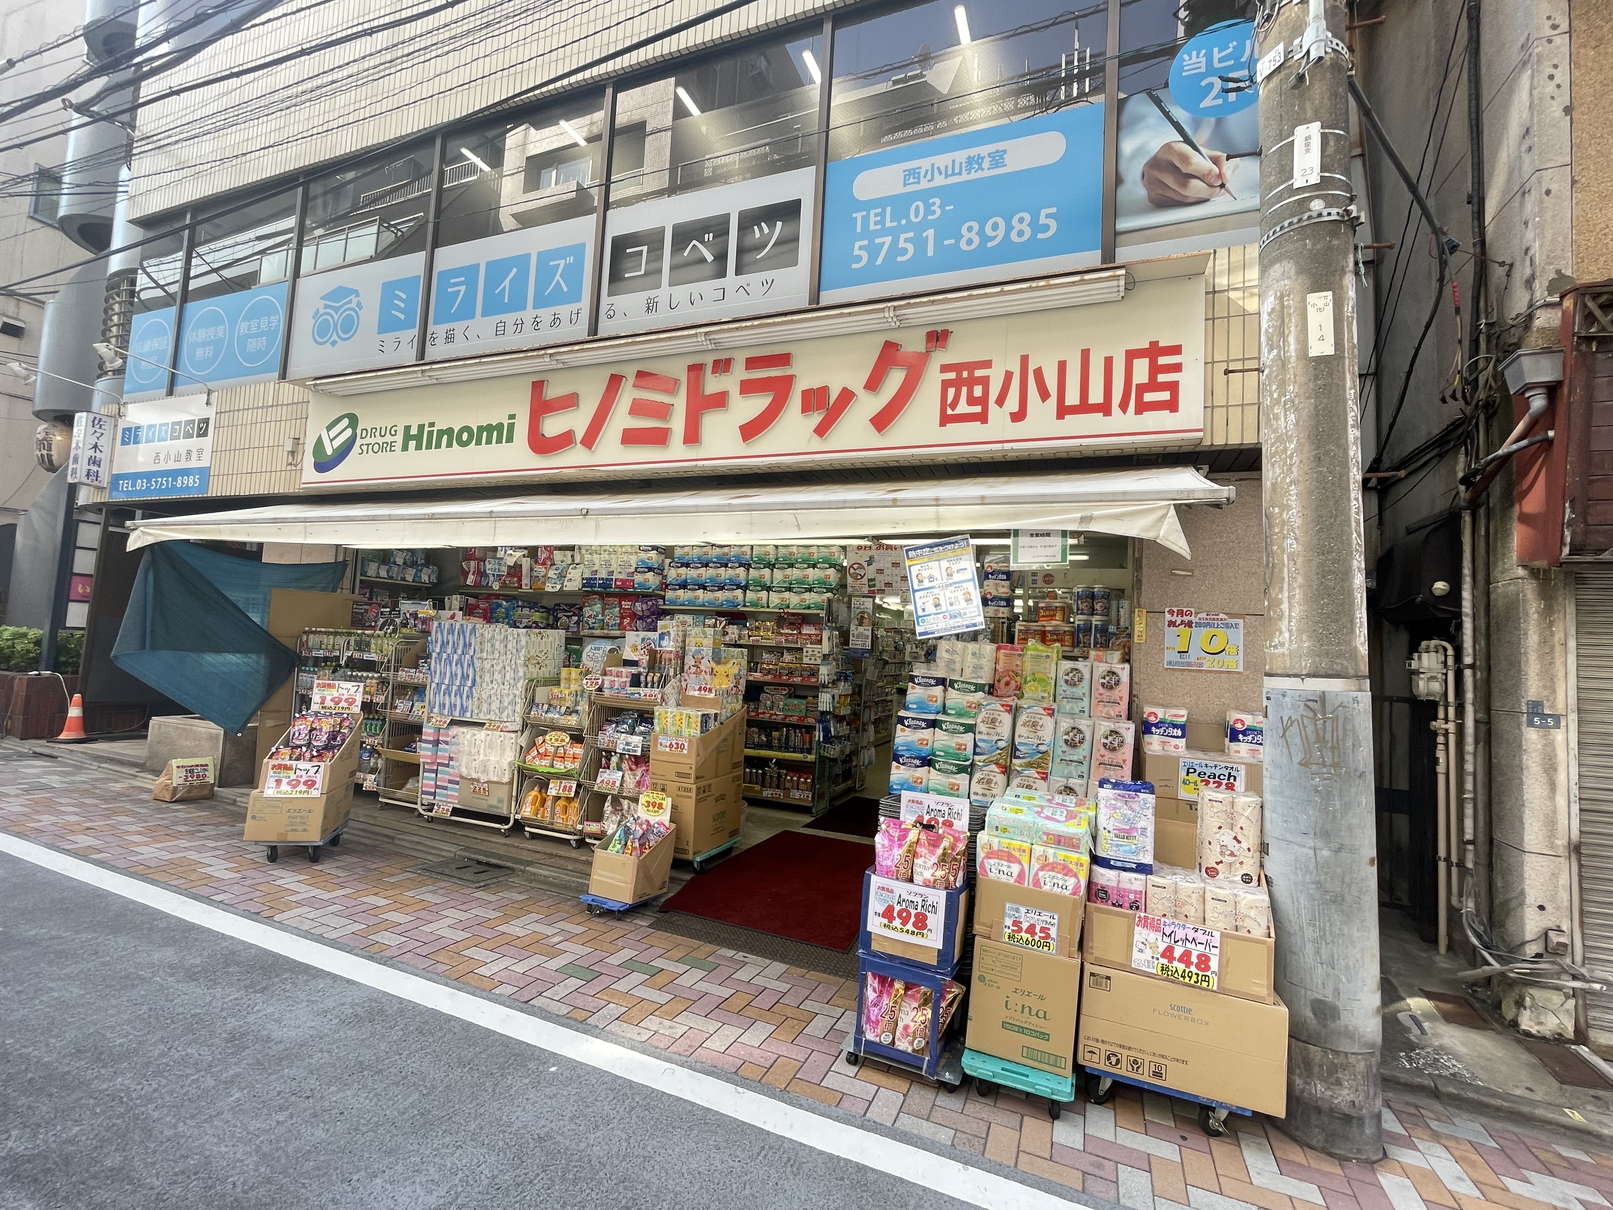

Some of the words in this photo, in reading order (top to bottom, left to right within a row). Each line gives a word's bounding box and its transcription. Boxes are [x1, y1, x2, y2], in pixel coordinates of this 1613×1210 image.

[902, 147, 1008, 188] 西小山教室
[852, 198, 955, 233] TEL.03-
[623, 219, 784, 280] コベツ
[851, 206, 1058, 270] 5751-8985
[392, 255, 575, 320] ミライズ
[527, 329, 953, 456] ヒノミドラッグ
[939, 340, 1183, 428] 西小山店
[360, 424, 398, 440] DRUG
[401, 413, 516, 453] Hinomi
[84, 415, 107, 484] 佐々木歯科
[358, 439, 397, 456] STORE
[319, 695, 357, 707] 199
[1534, 717, 1554, 726] 5-5
[273, 779, 317, 790] 199
[1186, 767, 1238, 783] Peach
[925, 804, 946, 819] Aroma
[947, 808, 963, 822] Richi
[896, 894, 919, 911] Aroma
[920, 899, 939, 915] Richi
[881, 904, 929, 931] 498
[1011, 919, 1052, 941] 545
[1161, 928, 1219, 953] トイレットペーパー
[1160, 944, 1212, 973] 448
[1155, 961, 1215, 989] (税込493円)
[1012, 987, 1047, 1001] エリエール
[1169, 1003, 1193, 1015] scottie
[1153, 1064, 1163, 1072] 10
